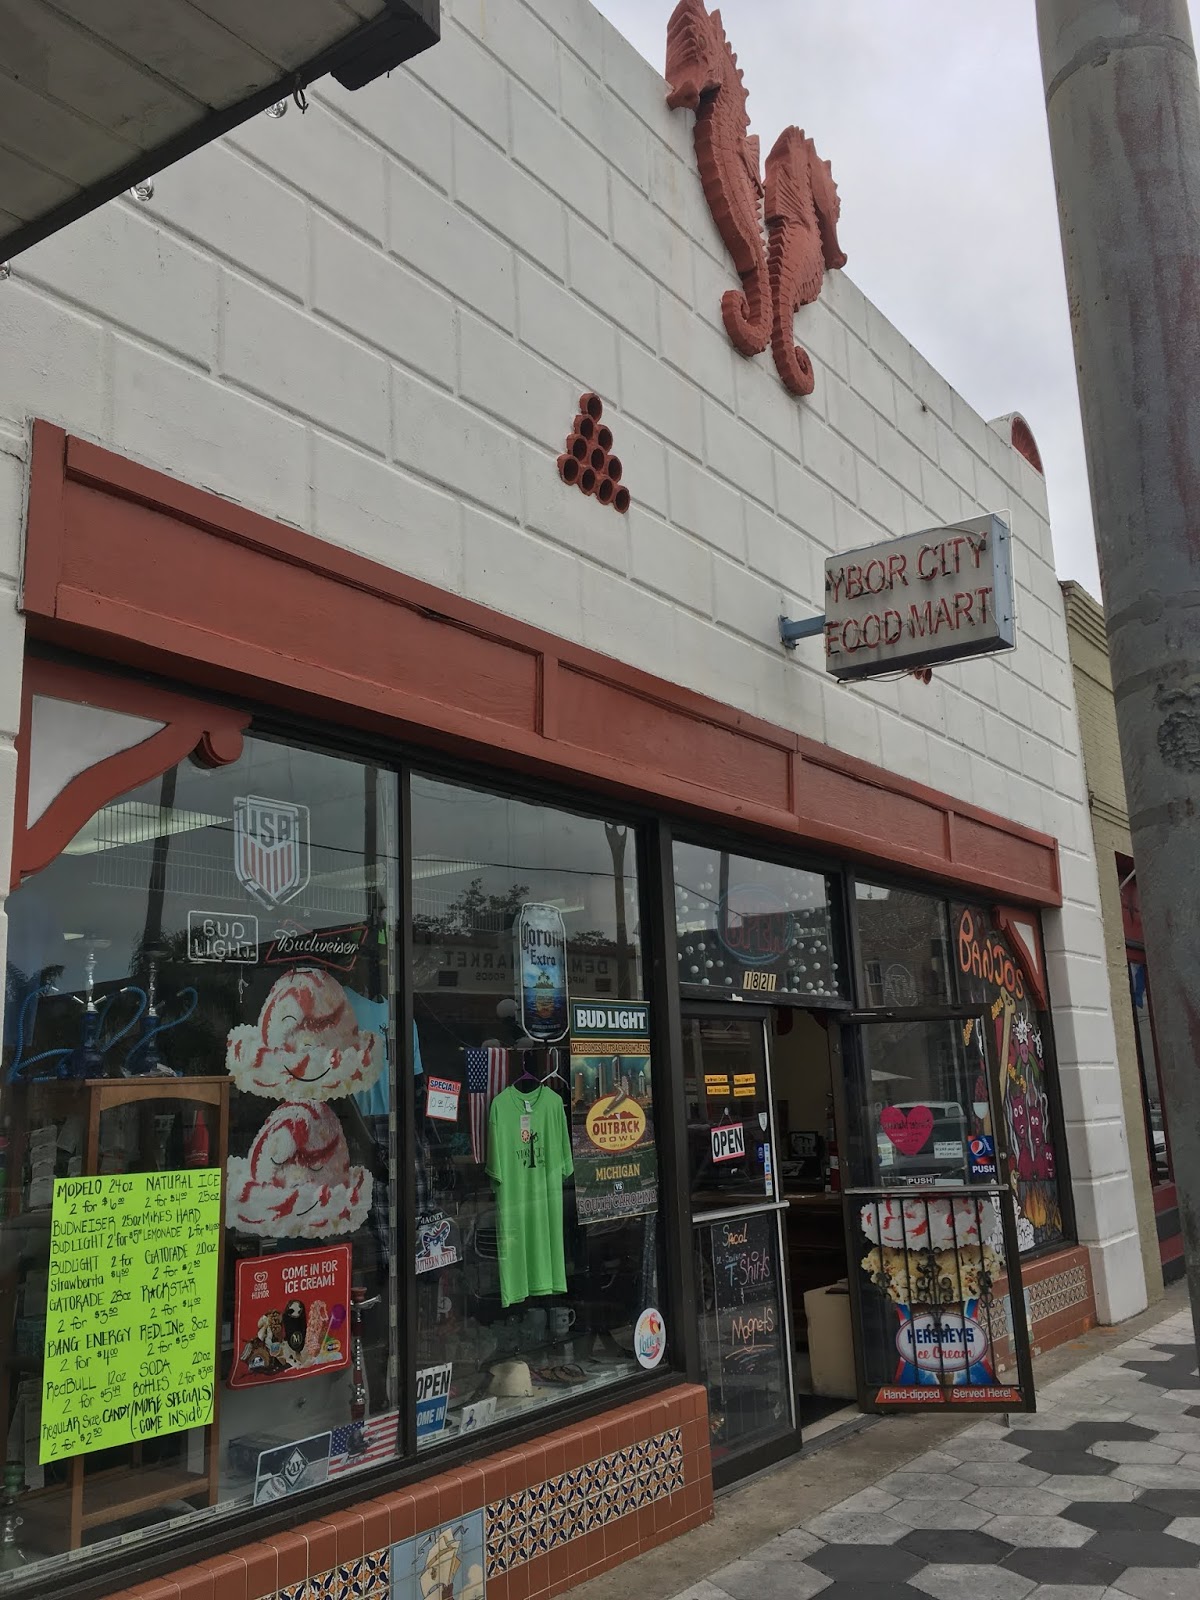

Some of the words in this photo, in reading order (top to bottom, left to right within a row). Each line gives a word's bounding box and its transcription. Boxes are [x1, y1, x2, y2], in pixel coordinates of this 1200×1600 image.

[825, 553, 908, 603] YBOR
[917, 531, 988, 582] CITY
[825, 608, 901, 657] FOOD
[908, 587, 993, 639] MART
[243, 807, 291, 848] USA
[203, 919, 245, 939] BUD
[522, 921, 564, 951] Coron
[194, 938, 256, 957] LIGHT
[273, 929, 360, 955] Budweiser
[529, 950, 556, 966] Extra
[744, 971, 776, 990] 1821
[576, 1009, 606, 1028] BUD
[607, 1010, 646, 1029] LIGHT
[429, 1080, 460, 1093] SPECIAL!
[592, 1120, 640, 1136] OUTBACK
[600, 1134, 636, 1143] BOWL
[713, 1127, 743, 1158] OPEN
[595, 1163, 641, 1181] MICHIGAN
[972, 1165, 995, 1173] PUSH
[57, 1179, 102, 1204] MODELO
[108, 1178, 133, 1194] 24oz
[146, 1174, 193, 1191] NATURAL
[197, 1173, 220, 1188] ICE
[69, 1203, 77, 1215] 2
[82, 1200, 97, 1213] for
[145, 1197, 151, 1208] 2
[154, 1194, 167, 1206] for
[577, 1194, 612, 1213] SOUTH
[176, 1208, 201, 1224] HARD
[53, 1216, 116, 1237] BUDWEISER
[143, 1225, 182, 1242] LEMONADE
[188, 1226, 194, 1239] 2
[194, 1223, 204, 1237] for
[107, 1234, 113, 1249] 2
[115, 1232, 128, 1247] for
[111, 1256, 117, 1268] 2
[119, 1254, 133, 1267] for
[281, 1264, 308, 1281] COME
[322, 1259, 338, 1274] FOR
[152, 1266, 159, 1280] 2
[163, 1265, 178, 1277] for
[253, 1283, 268, 1292] GOOD
[284, 1280, 299, 1294] ICE
[300, 1273, 336, 1291] CREAM!
[49, 1291, 105, 1313] GATORADE
[251, 1290, 270, 1300] HUMOR
[150, 1307, 157, 1319] 2
[161, 1304, 177, 1316] for
[57, 1319, 65, 1333] 2
[70, 1316, 87, 1331] for
[732, 1307, 774, 1350] Magnets
[47, 1336, 81, 1358] BANG
[86, 1327, 131, 1349] ENERGY
[907, 1327, 976, 1344] HERSHEYS
[147, 1342, 155, 1356] 2
[158, 1340, 173, 1354] for
[59, 1358, 70, 1372] 2
[74, 1355, 92, 1370] for
[139, 1358, 172, 1378] SODA
[178, 1372, 183, 1386] 2
[185, 1371, 196, 1385] for
[416, 1370, 450, 1401] OPEN
[62, 1398, 72, 1414] 2
[78, 1393, 95, 1409] for
[883, 1389, 941, 1400] Hand-dipped
[953, 1388, 985, 1399] Served
[987, 1388, 1012, 1398] Here!
[102, 1403, 131, 1423] CANDY
[416, 1409, 436, 1426] OME
[435, 1406, 445, 1422] IN
[50, 1443, 58, 1456] 2
[61, 1438, 76, 1451] for
